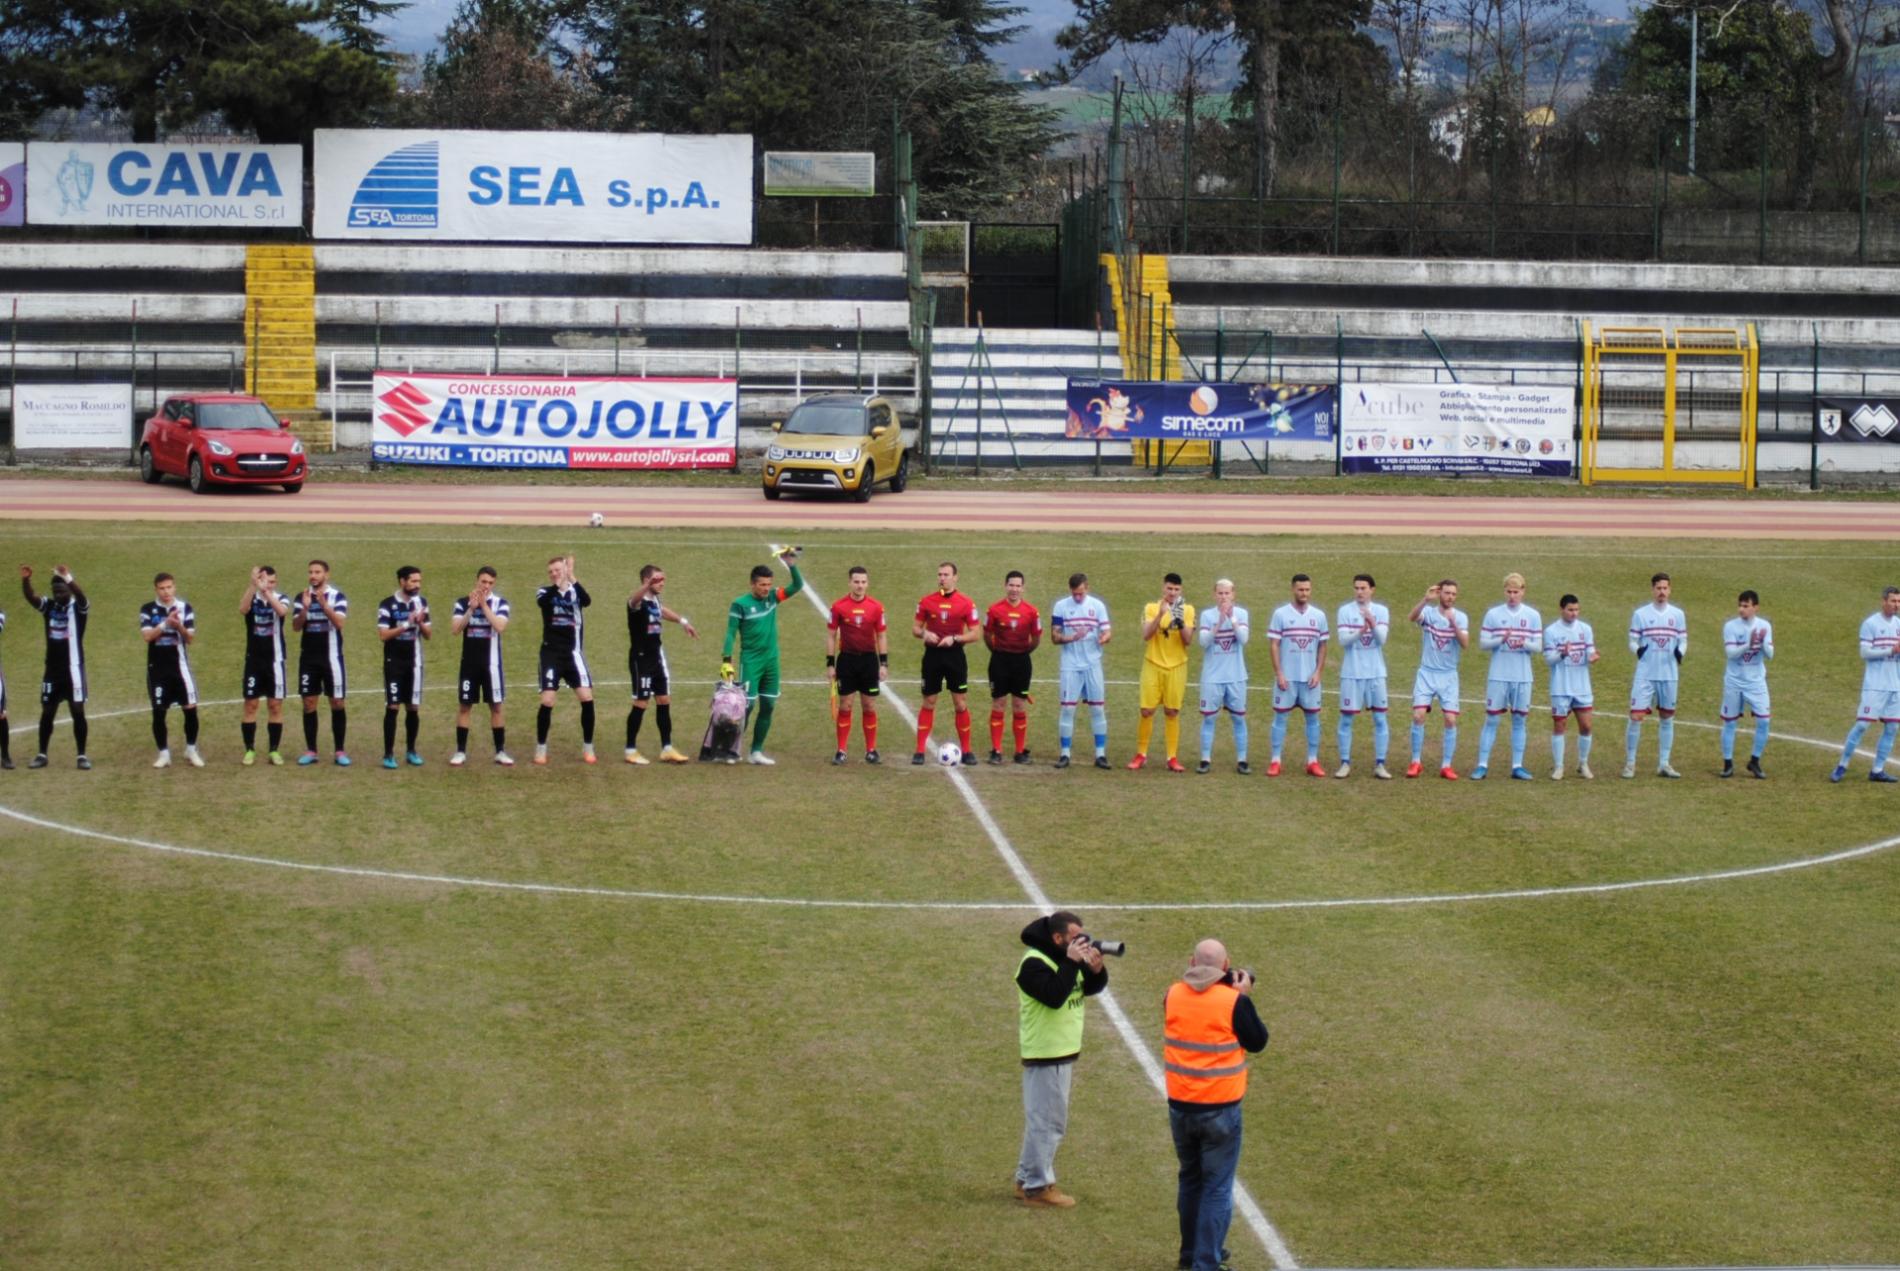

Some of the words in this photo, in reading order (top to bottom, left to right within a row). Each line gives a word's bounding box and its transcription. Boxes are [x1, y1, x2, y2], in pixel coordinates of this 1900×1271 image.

[107, 150, 283, 197] CAVA
[468, 165, 585, 206] SEA
[607, 180, 721, 214] S.p.A.
[107, 203, 249, 218] INTERNATIONAL
[350, 208, 395, 226] SEA
[447, 382, 577, 397] CONCESSIONARIA
[1439, 390, 1471, 399] Grafica
[1518, 394, 1550, 403] Gadget
[1504, 405, 1567, 415] personalizzato
[430, 397, 734, 439] AUTOJOLLY
[1161, 416, 1245, 432] simecom
[373, 444, 450, 461] SUZUKI
[469, 446, 568, 465] TORTONA
[572, 448, 731, 466] www.autojollysrl.com
[301, 674, 310, 685] 2
[545, 669, 554, 680] 4
[247, 677, 256, 688] 3
[389, 682, 398, 693] 5
[461, 680, 471, 691] 6
